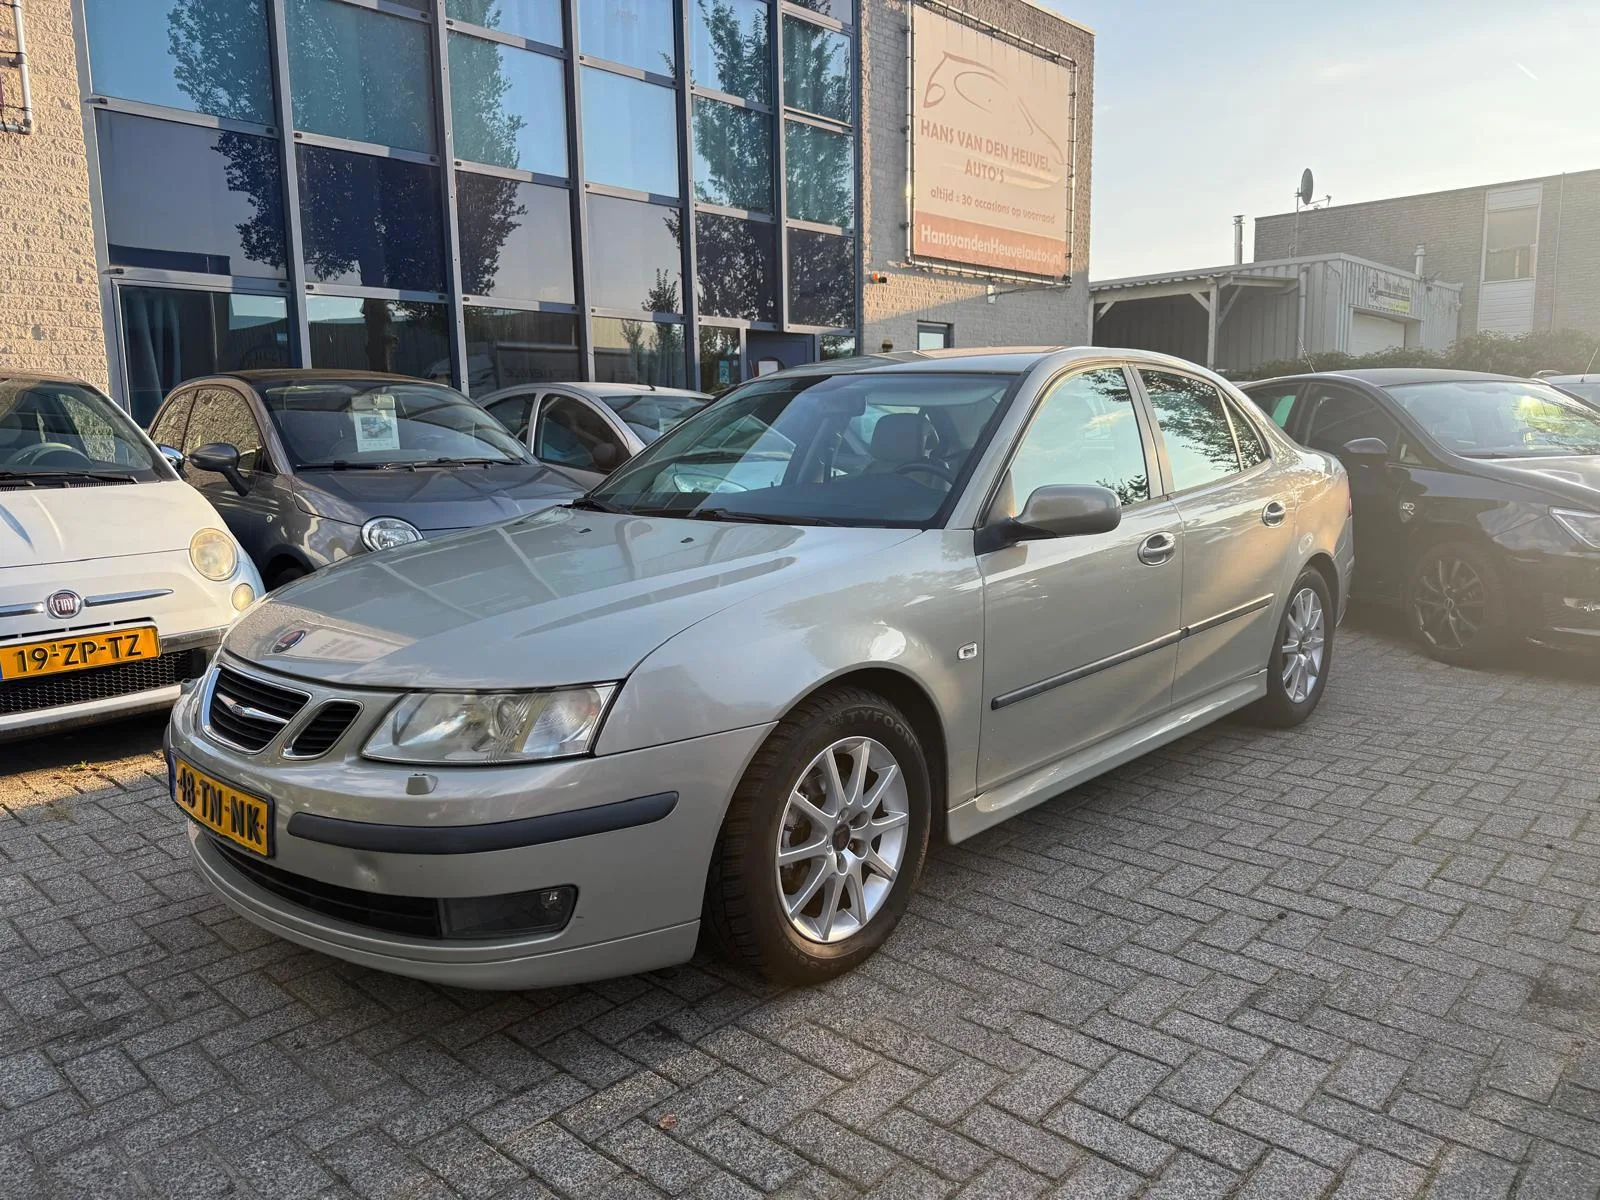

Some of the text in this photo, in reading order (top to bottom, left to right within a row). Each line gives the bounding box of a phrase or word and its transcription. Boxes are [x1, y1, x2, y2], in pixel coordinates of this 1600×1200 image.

[920, 118, 1051, 172] HANS VAN DEN HEUVEL
[964, 159, 1005, 183] AUTO'S
[930, 186, 954, 202] altijd
[961, 194, 973, 206] 30
[974, 199, 1010, 214] occasions
[1011, 207, 1022, 217] op
[920, 224, 1062, 264] HansvandenHeuvelautos.nl
[55, 598, 74, 611] FIAT
[17, 633, 142, 672] 19-ZP-TZ
[178, 767, 262, 846] 48-TN-NK
